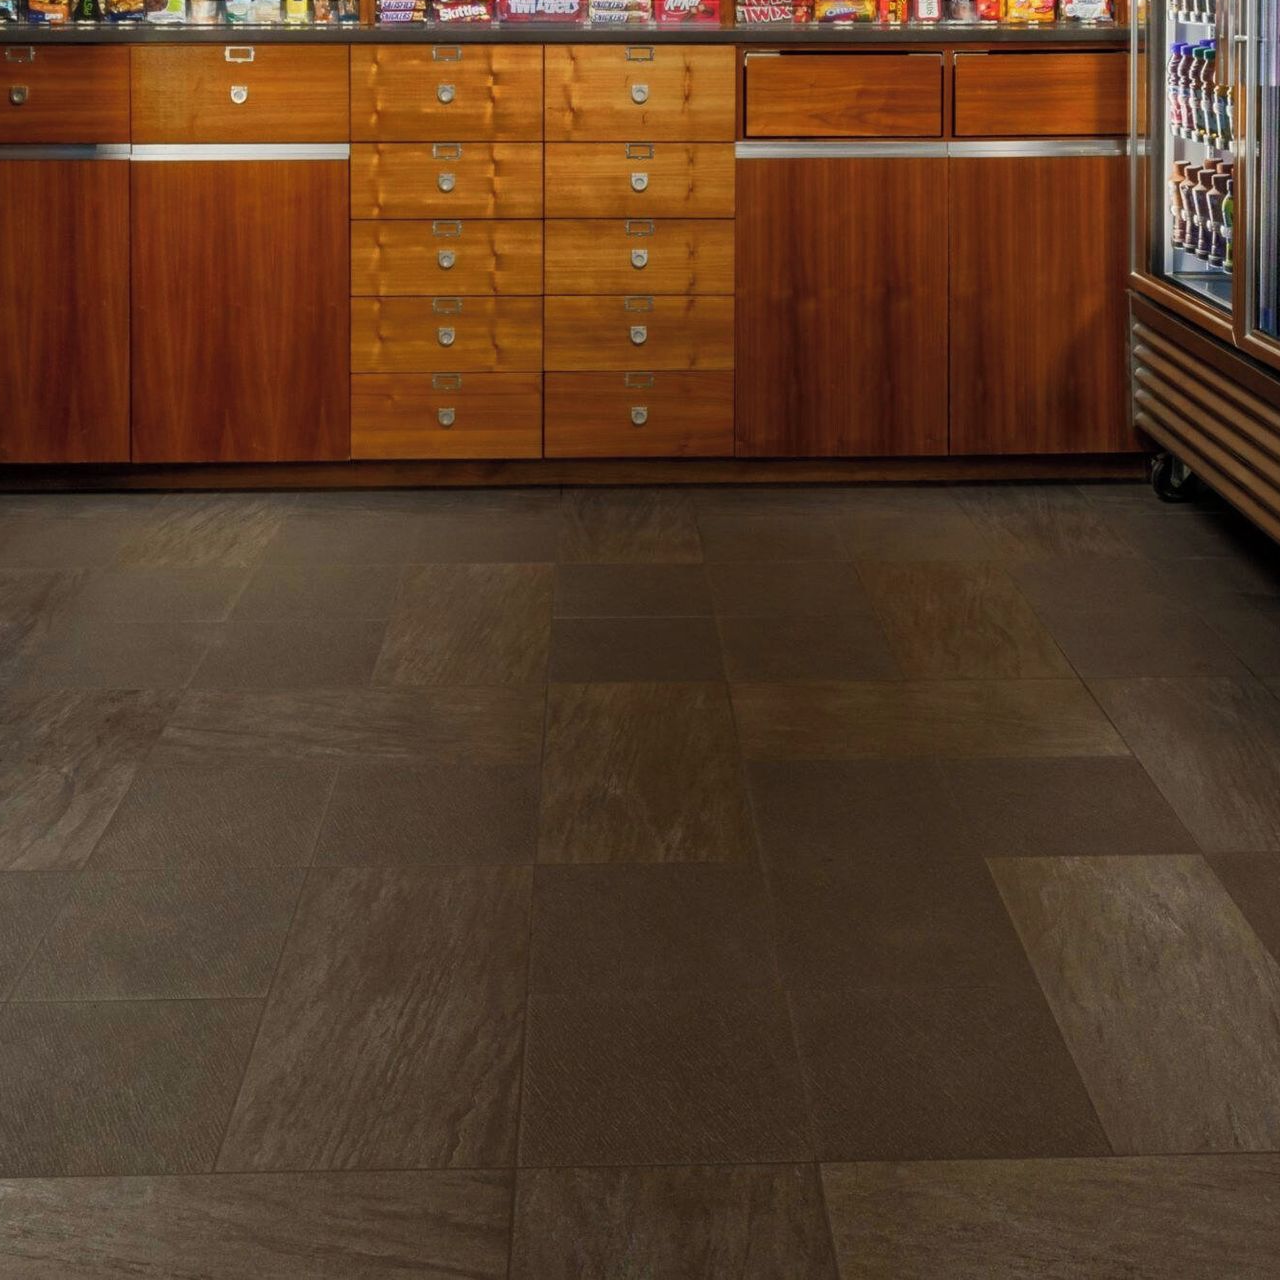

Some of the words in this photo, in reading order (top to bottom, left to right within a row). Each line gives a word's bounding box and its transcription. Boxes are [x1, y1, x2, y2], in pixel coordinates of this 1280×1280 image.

[591, 0, 625, 10] SNICKERS
[379, 11, 413, 21] SNICKERS
[439, 5, 488, 21] Skittles
[743, 6, 793, 22] TWIX
